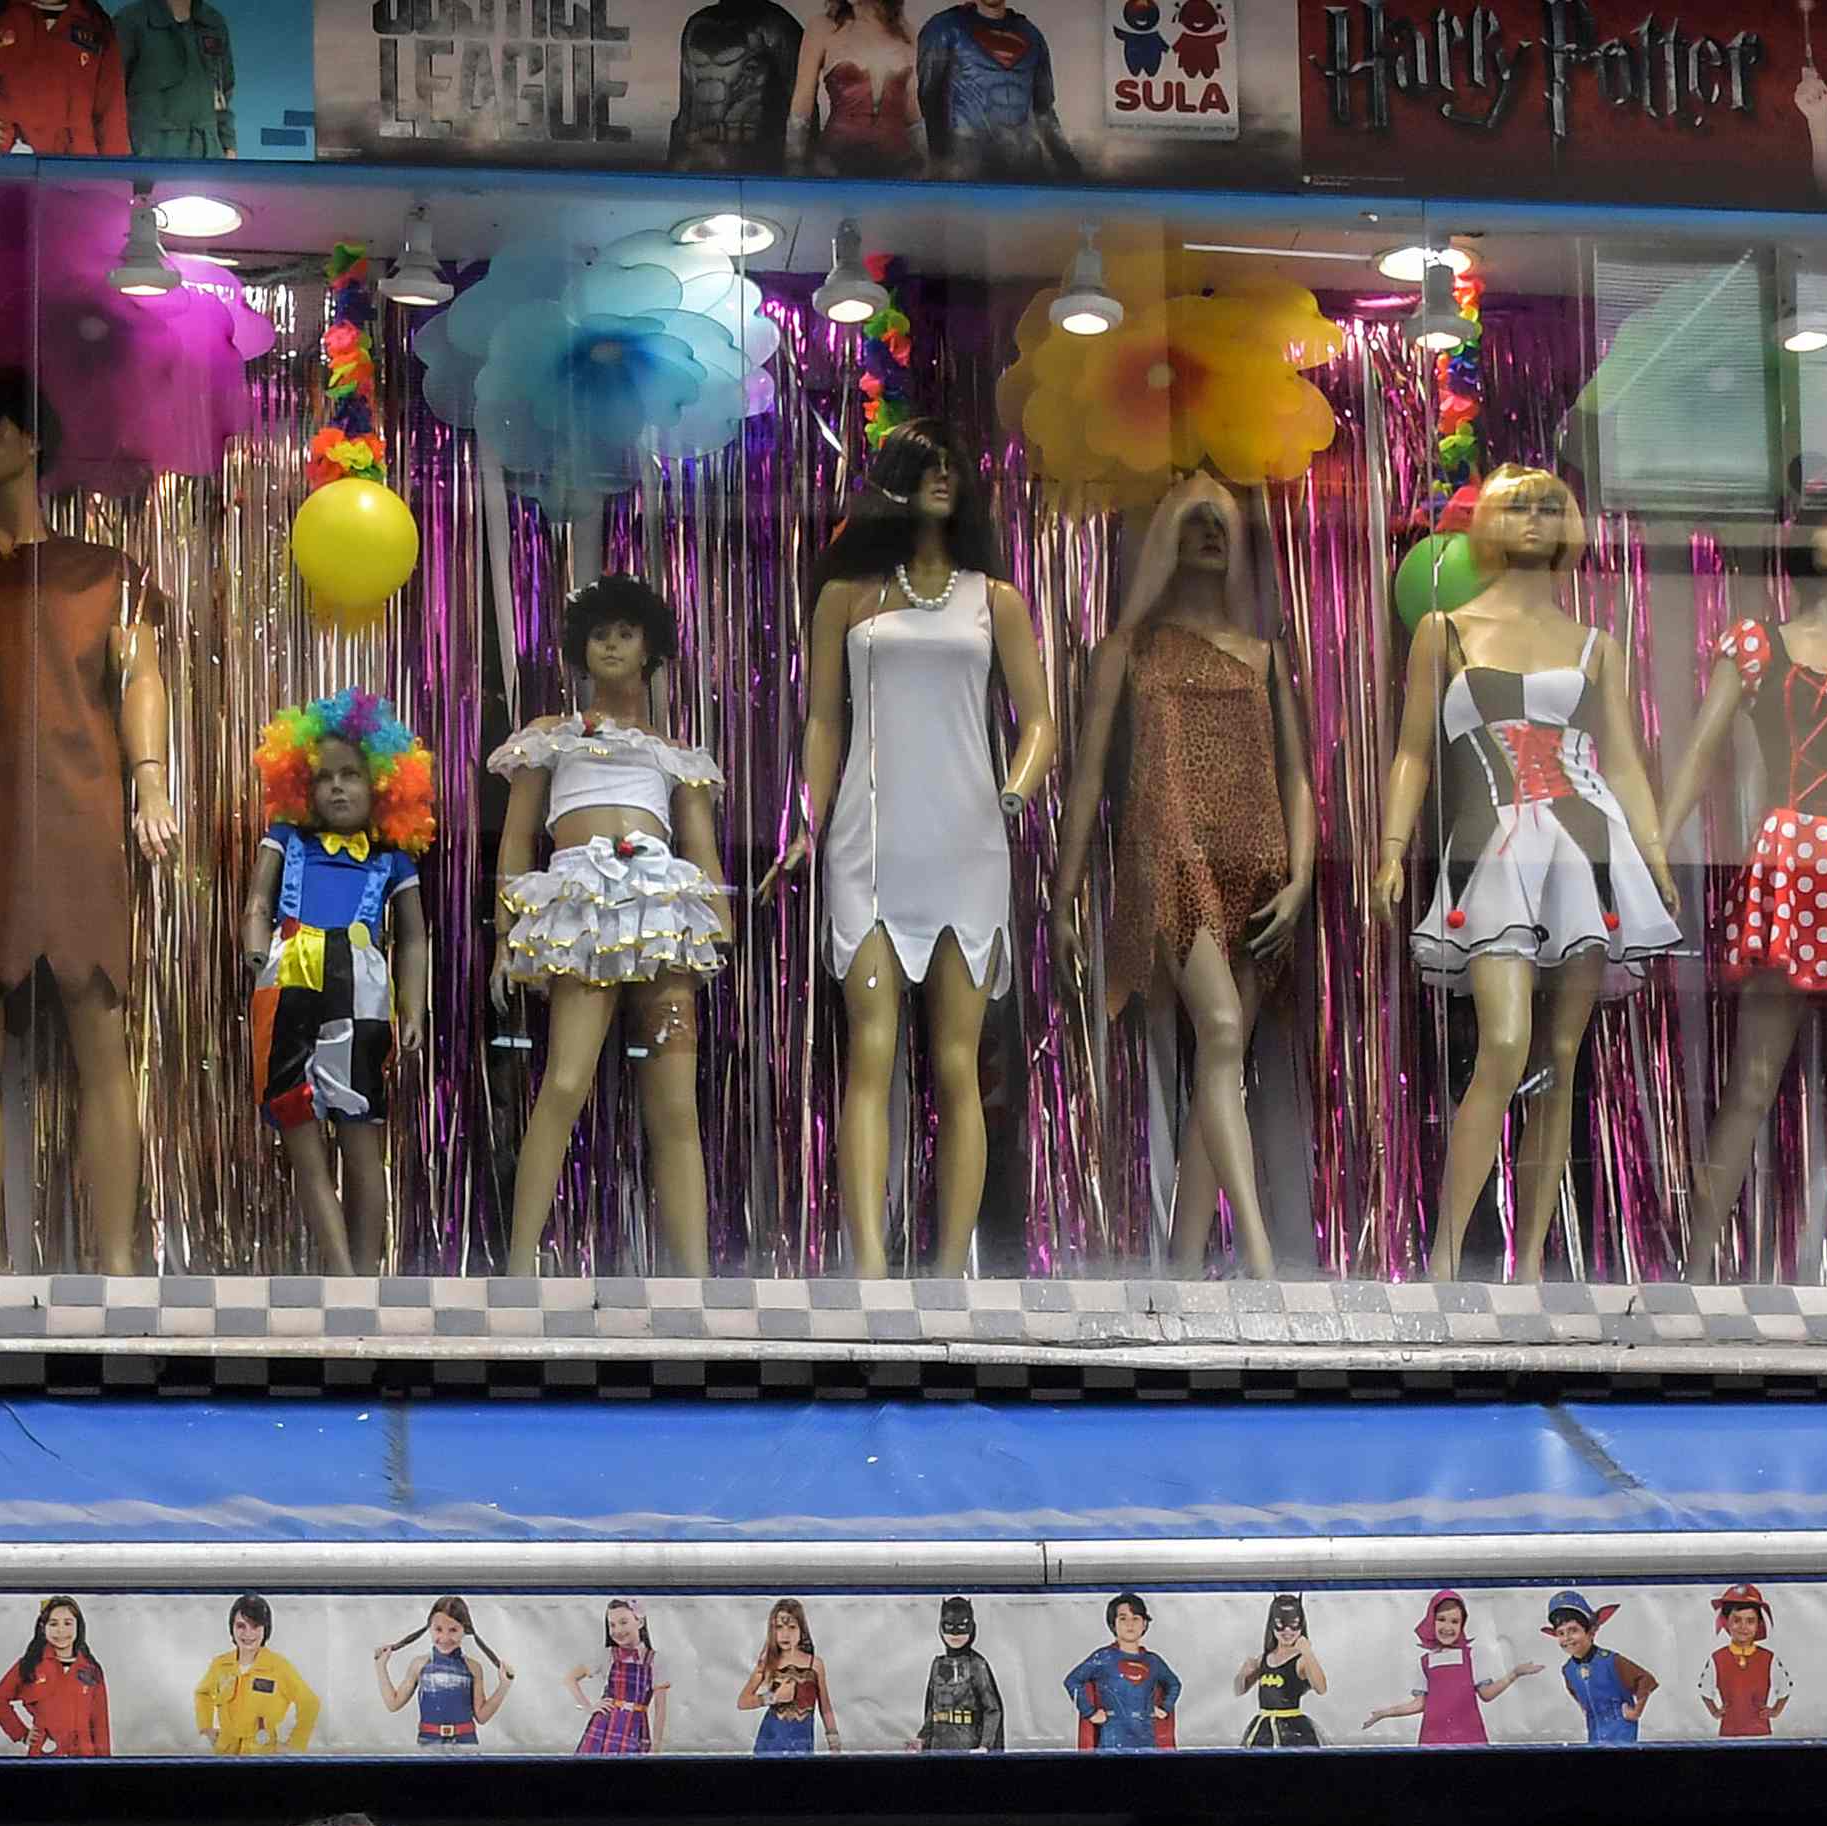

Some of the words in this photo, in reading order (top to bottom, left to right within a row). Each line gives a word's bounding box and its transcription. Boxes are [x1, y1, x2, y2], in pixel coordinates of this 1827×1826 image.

[377, 38, 632, 142] LEAGUE
[1114, 79, 1230, 114] SULA
[1307, 0, 1532, 128] Harry
[1541, 0, 1761, 137] Potter
